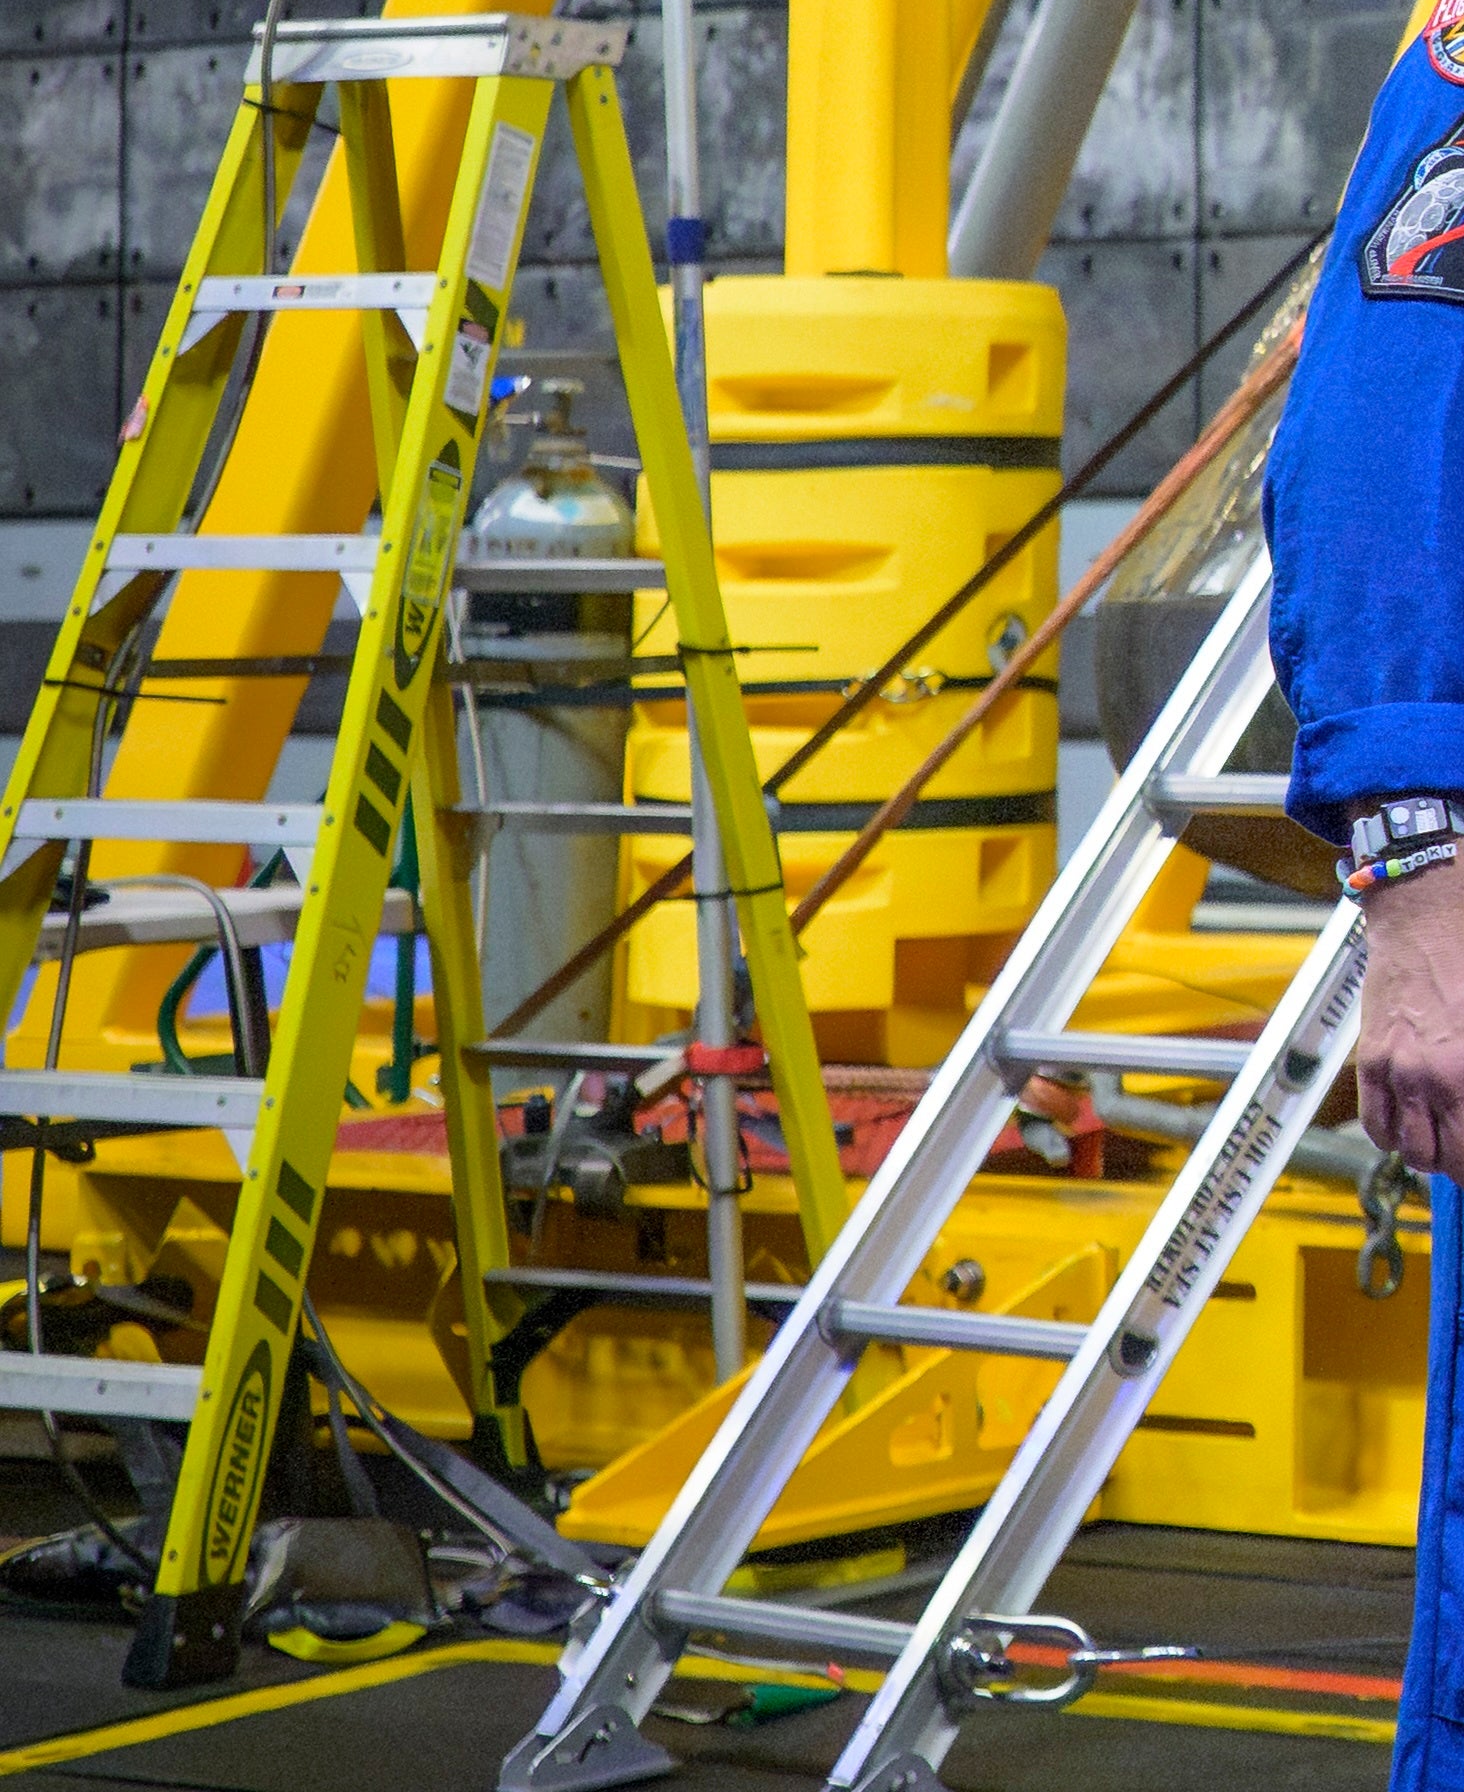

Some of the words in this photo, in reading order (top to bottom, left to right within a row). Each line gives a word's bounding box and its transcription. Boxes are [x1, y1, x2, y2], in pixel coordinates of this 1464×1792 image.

[1244, 1115, 1284, 1166] FOR
[1215, 1170, 1252, 1223] USE
[1193, 1228, 1221, 1261] AT
[1162, 1263, 1201, 1309] SEA
[211, 1390, 261, 1560] WERNER
